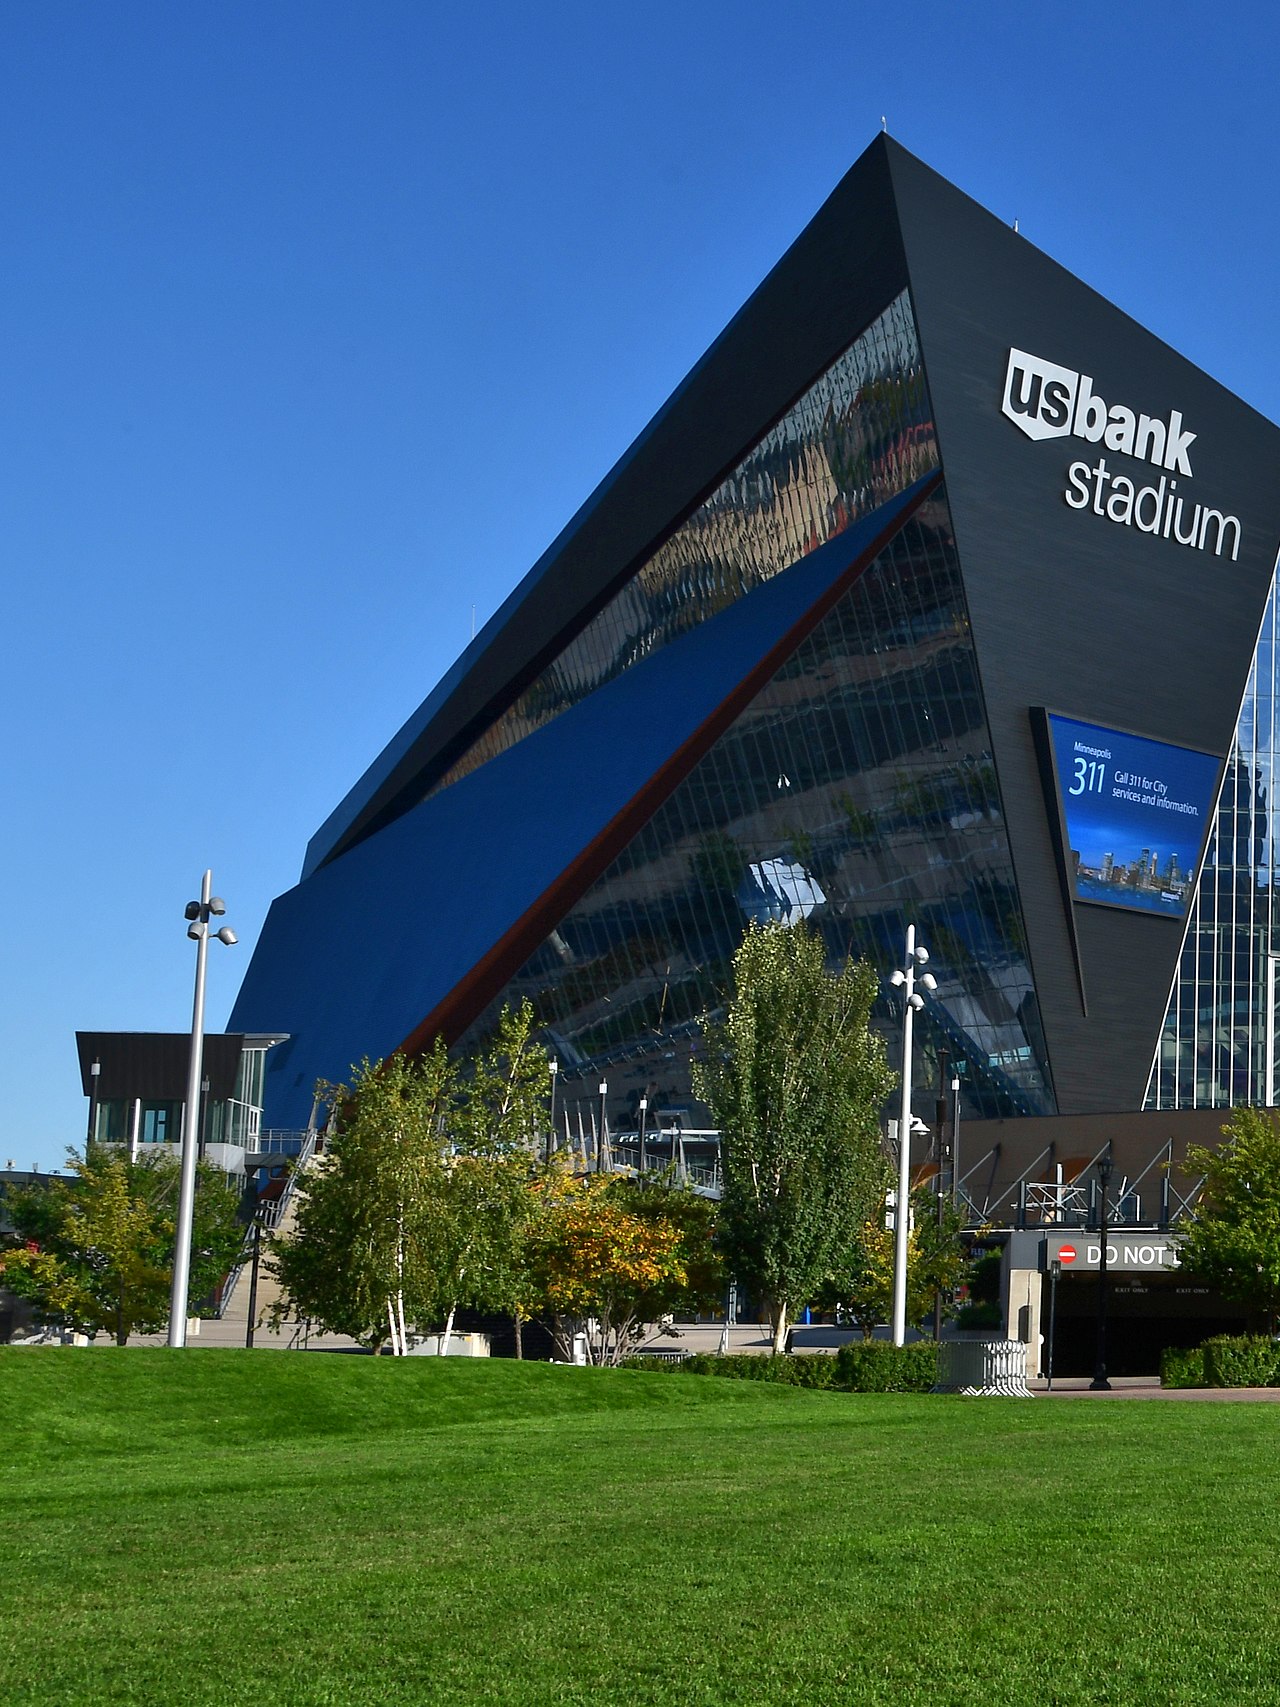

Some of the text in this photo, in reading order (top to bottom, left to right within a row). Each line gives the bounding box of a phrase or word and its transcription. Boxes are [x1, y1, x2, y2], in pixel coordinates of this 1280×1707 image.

[1064, 458, 1242, 562] stadium
[1073, 741, 1112, 760] Minneapolis
[1068, 757, 1106, 796] 311
[1114, 770, 1168, 796] Call 311 for City
[1111, 786, 1199, 816] services and information.
[1087, 1245, 1118, 1264] DO
[1124, 1246, 1168, 1264] NOT
[1175, 1287, 1209, 1295] EXIT ONLY
